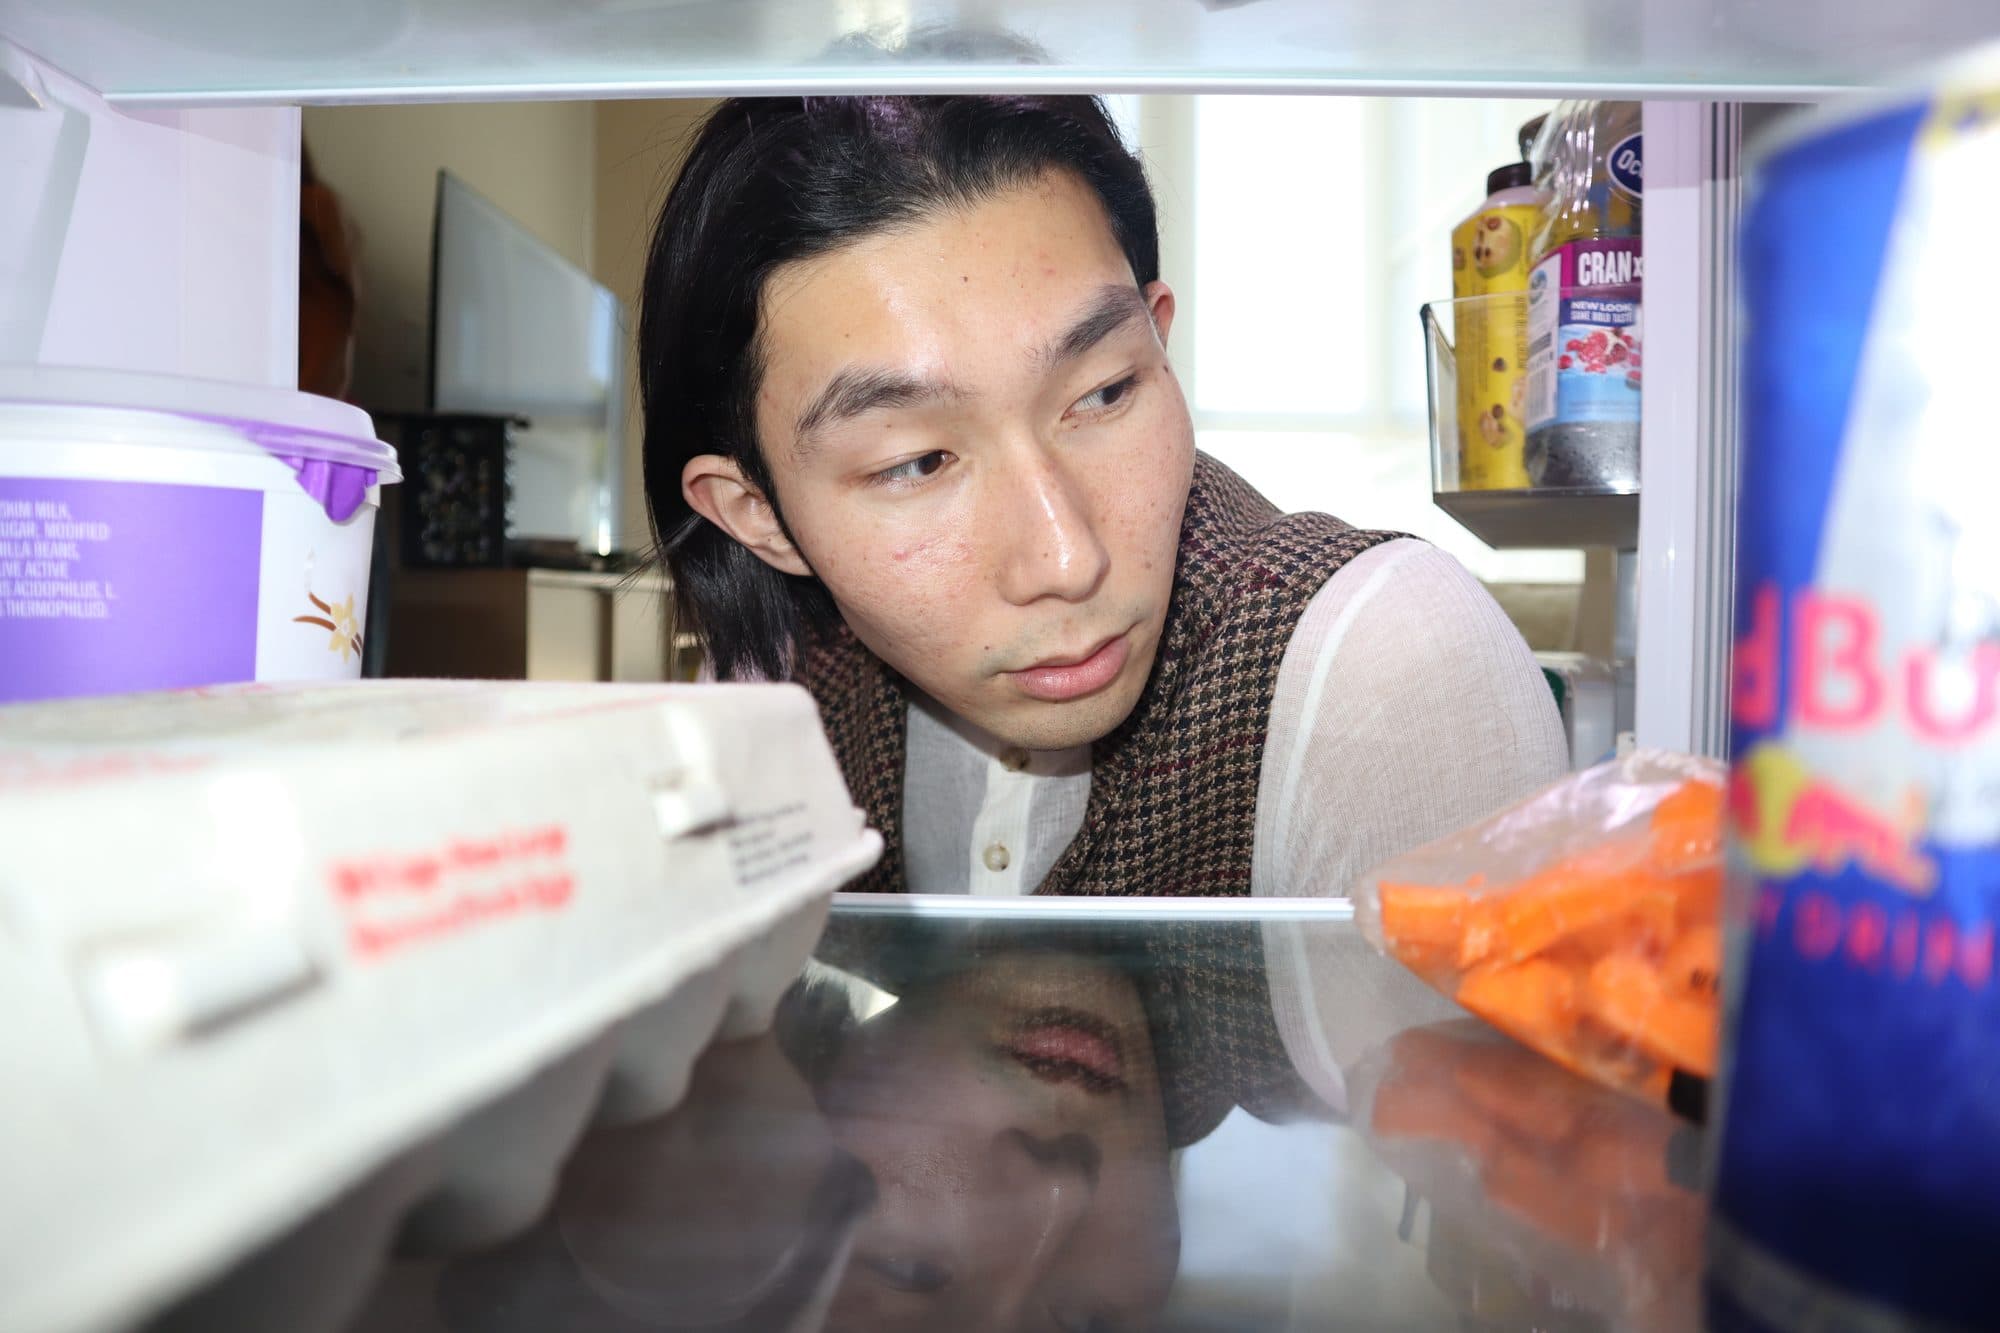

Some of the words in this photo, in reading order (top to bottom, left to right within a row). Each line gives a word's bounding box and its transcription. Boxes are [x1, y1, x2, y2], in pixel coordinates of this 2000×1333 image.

[1617, 149, 1642, 176] Oc
[1571, 301, 1599, 311] NEW
[1600, 303, 1632, 313] LOOK
[44, 521, 110, 541] MODIFIED
[24, 561, 68, 578] ACTIVE
